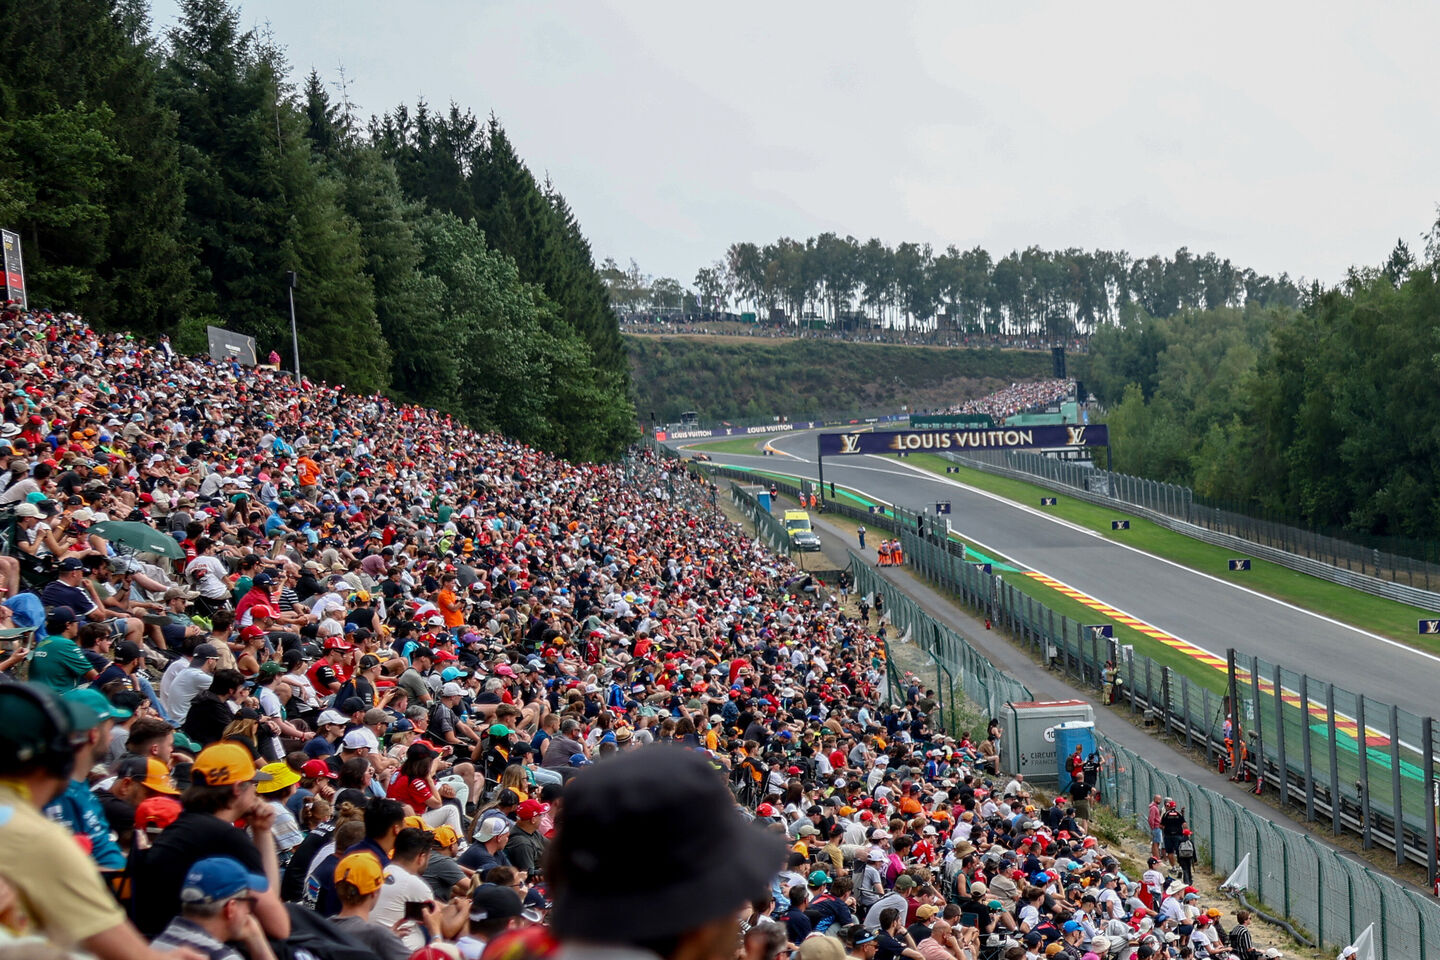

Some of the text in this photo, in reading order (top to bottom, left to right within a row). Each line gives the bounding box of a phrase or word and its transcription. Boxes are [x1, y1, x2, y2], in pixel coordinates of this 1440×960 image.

[747, 424, 793, 434] LOUIS VUITTON
[671, 430, 712, 440] LOUIS VUITTON
[898, 430, 1033, 450] LOUIS VUITTON
